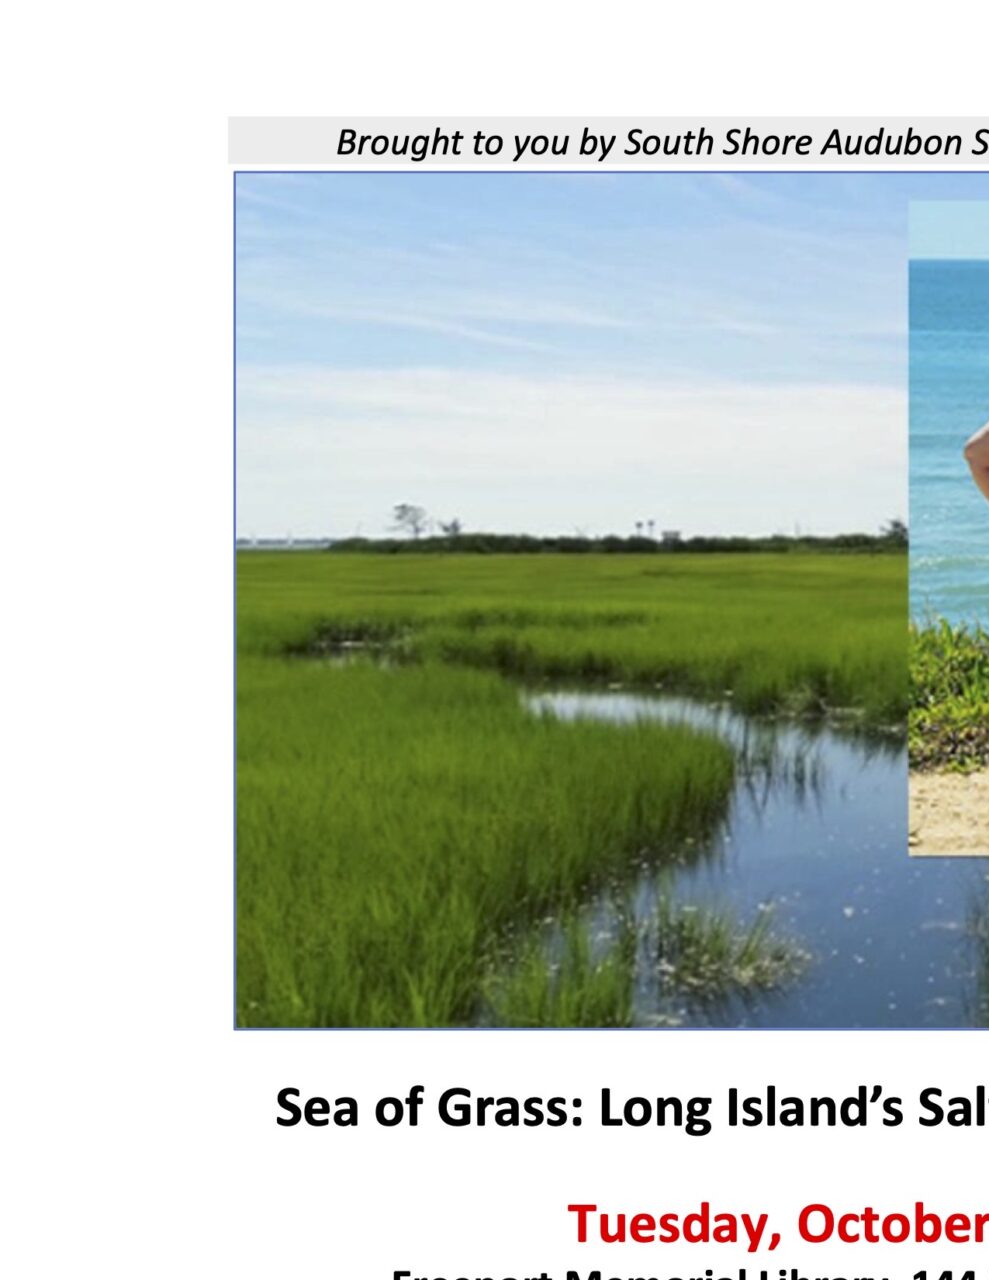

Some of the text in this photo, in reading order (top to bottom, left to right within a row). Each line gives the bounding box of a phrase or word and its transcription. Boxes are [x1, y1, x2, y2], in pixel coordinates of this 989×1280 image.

[337, 127, 464, 162] Brought
[473, 131, 503, 155] to
[513, 135, 569, 162] you
[579, 127, 616, 162] by
[624, 127, 713, 155] South
[723, 127, 812, 155] Shore
[820, 127, 962, 155] Audubon
[277, 1087, 358, 1127] Sea
[375, 1085, 424, 1127] of
[438, 1087, 582, 1127] Grass:
[601, 1088, 712, 1136] Long
[729, 1085, 903, 1127] Island’s
[567, 1201, 781, 1253] Tuesday,
